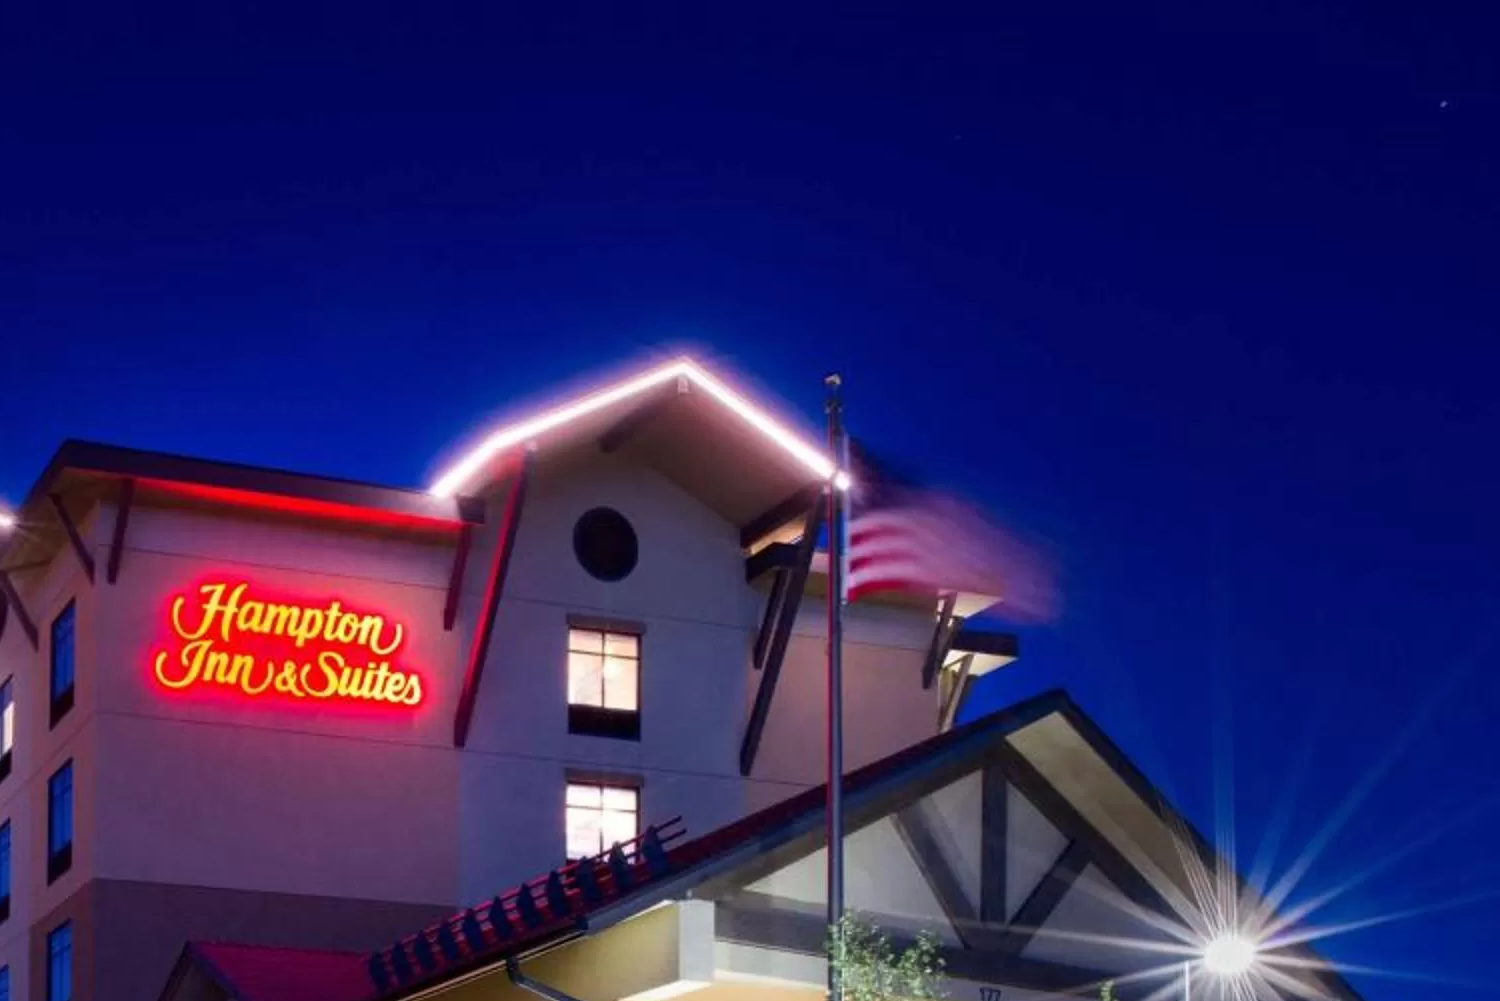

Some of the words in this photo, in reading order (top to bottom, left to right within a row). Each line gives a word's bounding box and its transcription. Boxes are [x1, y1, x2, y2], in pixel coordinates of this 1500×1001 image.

[173, 583, 403, 655] Hampton
[155, 639, 274, 694] Inn
[275, 660, 306, 697] &
[301, 651, 422, 705] Suites
